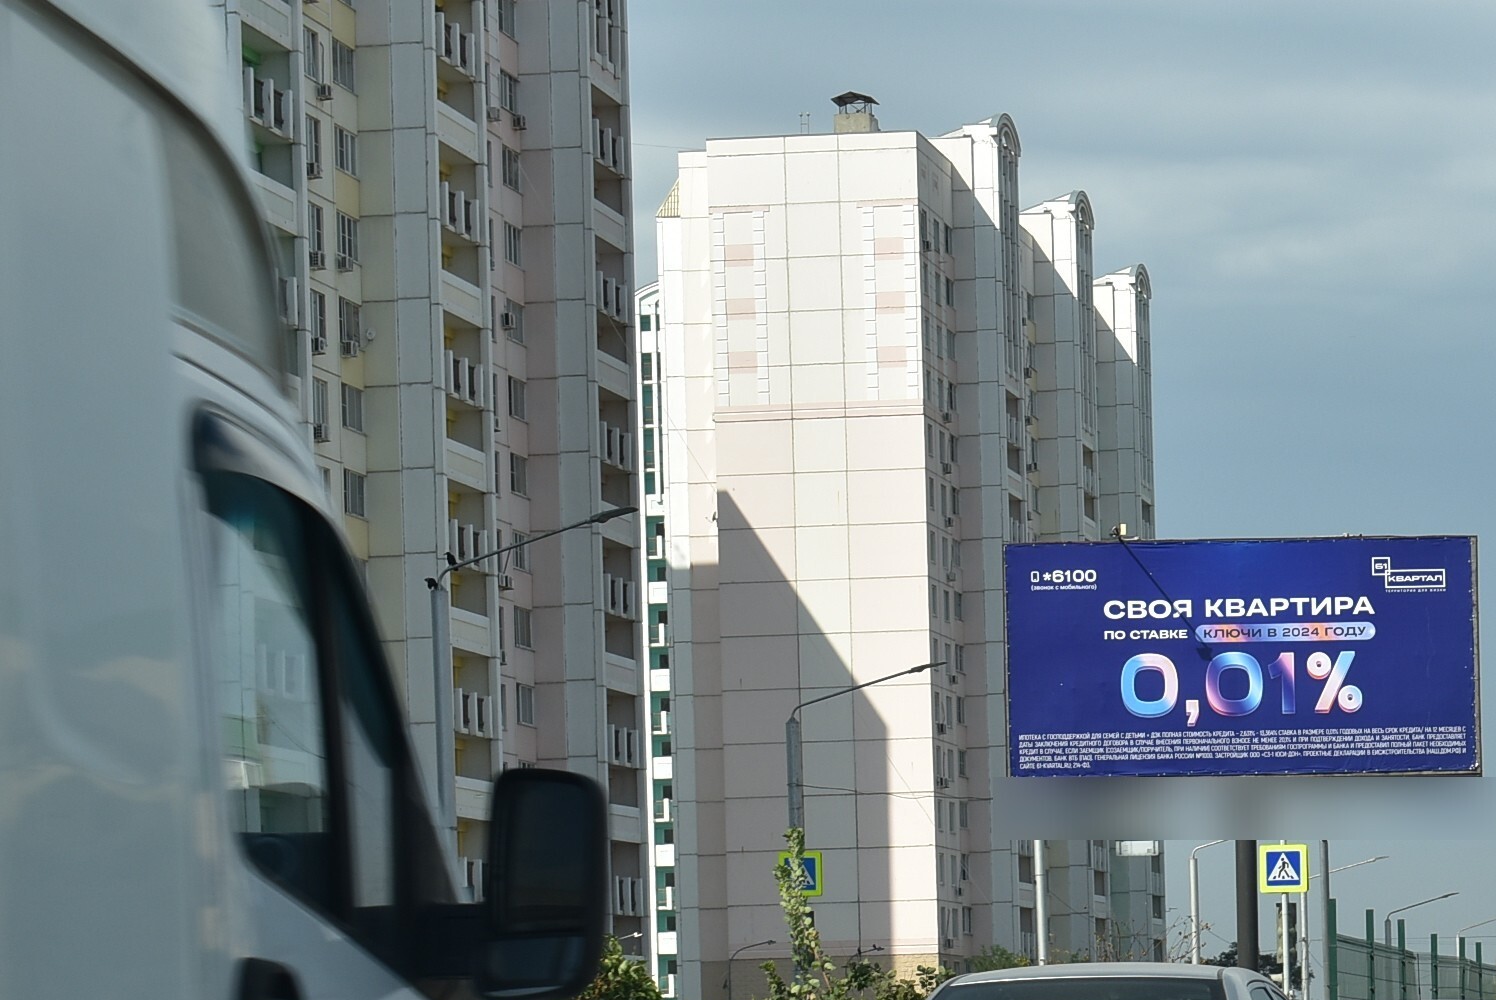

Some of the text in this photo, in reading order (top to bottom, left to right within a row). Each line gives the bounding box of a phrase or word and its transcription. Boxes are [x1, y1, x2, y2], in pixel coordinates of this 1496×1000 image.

[1104, 596, 1375, 620] СВОЯ КВАРТИРА
[1104, 629, 1188, 640] ПО СТАВКЕ
[1203, 626, 1366, 639] КЛЮЧИ В 2024 ГОДУ
[1120, 650, 1363, 726] 0,01%
